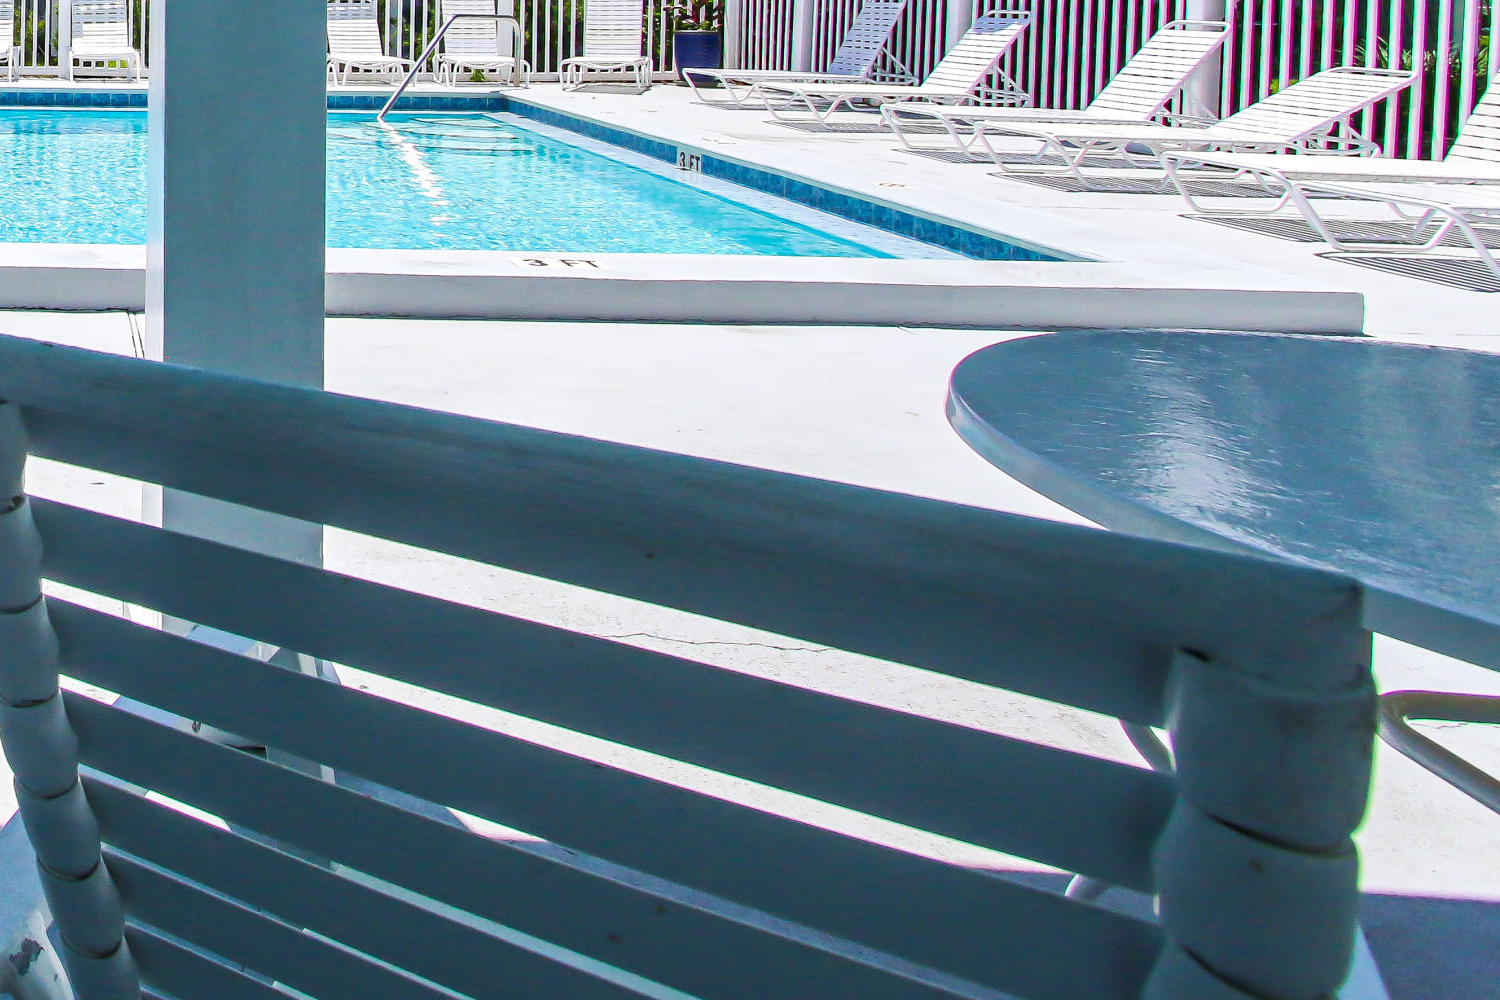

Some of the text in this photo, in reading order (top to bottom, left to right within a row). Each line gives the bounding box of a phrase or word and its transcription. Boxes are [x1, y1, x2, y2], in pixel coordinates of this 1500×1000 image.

[680, 152, 701, 171] 3 FT
[523, 258, 601, 268] 3 FT
